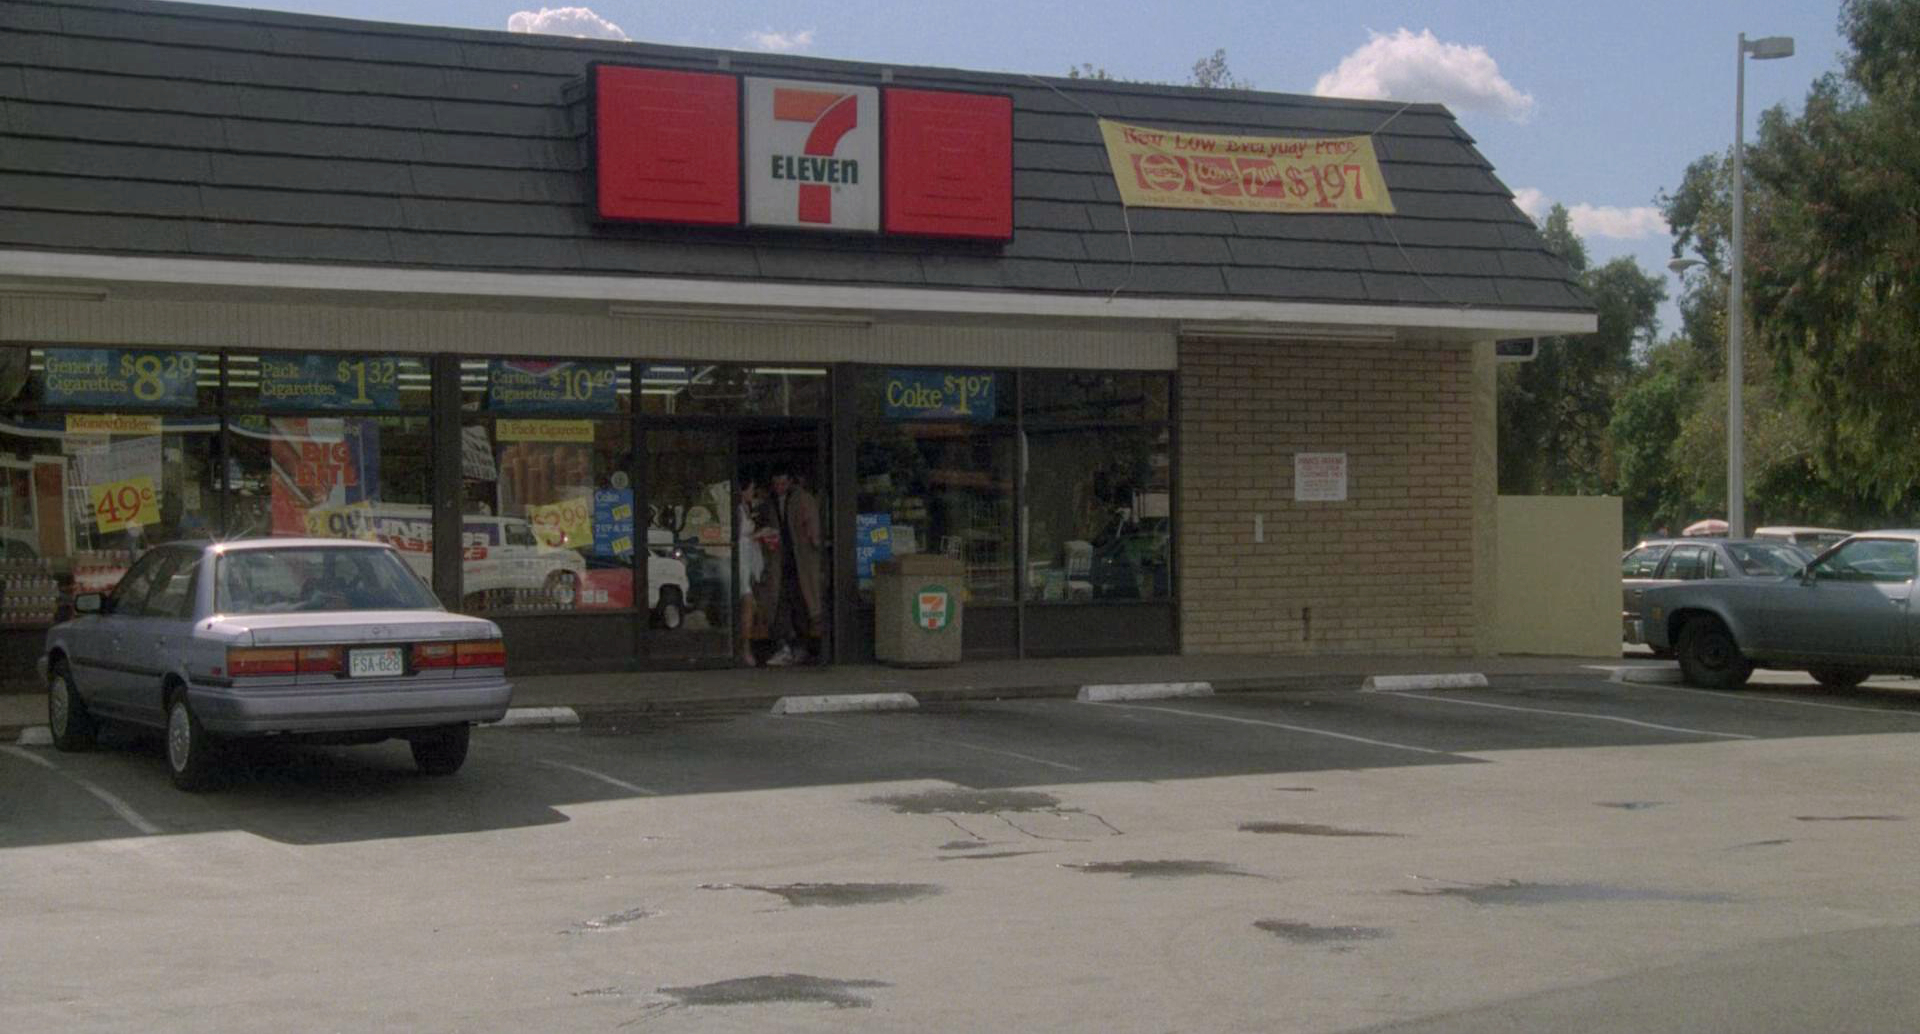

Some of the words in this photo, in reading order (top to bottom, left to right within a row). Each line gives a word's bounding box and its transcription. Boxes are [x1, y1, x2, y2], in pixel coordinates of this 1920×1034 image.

[1123, 127, 1163, 146] New
[1225, 136, 1306, 159] Everyday
[1314, 137, 1359, 156] Price
[47, 356, 108, 374] Generic
[261, 361, 301, 379] Pack
[47, 375, 128, 395] Cigarettes
[491, 370, 537, 384] Carton
[261, 379, 336, 399] Cigarettes
[491, 385, 559, 403] Cigarettes
[887, 378, 943, 409] Coke
[352, 656, 400, 673] FSA-628
